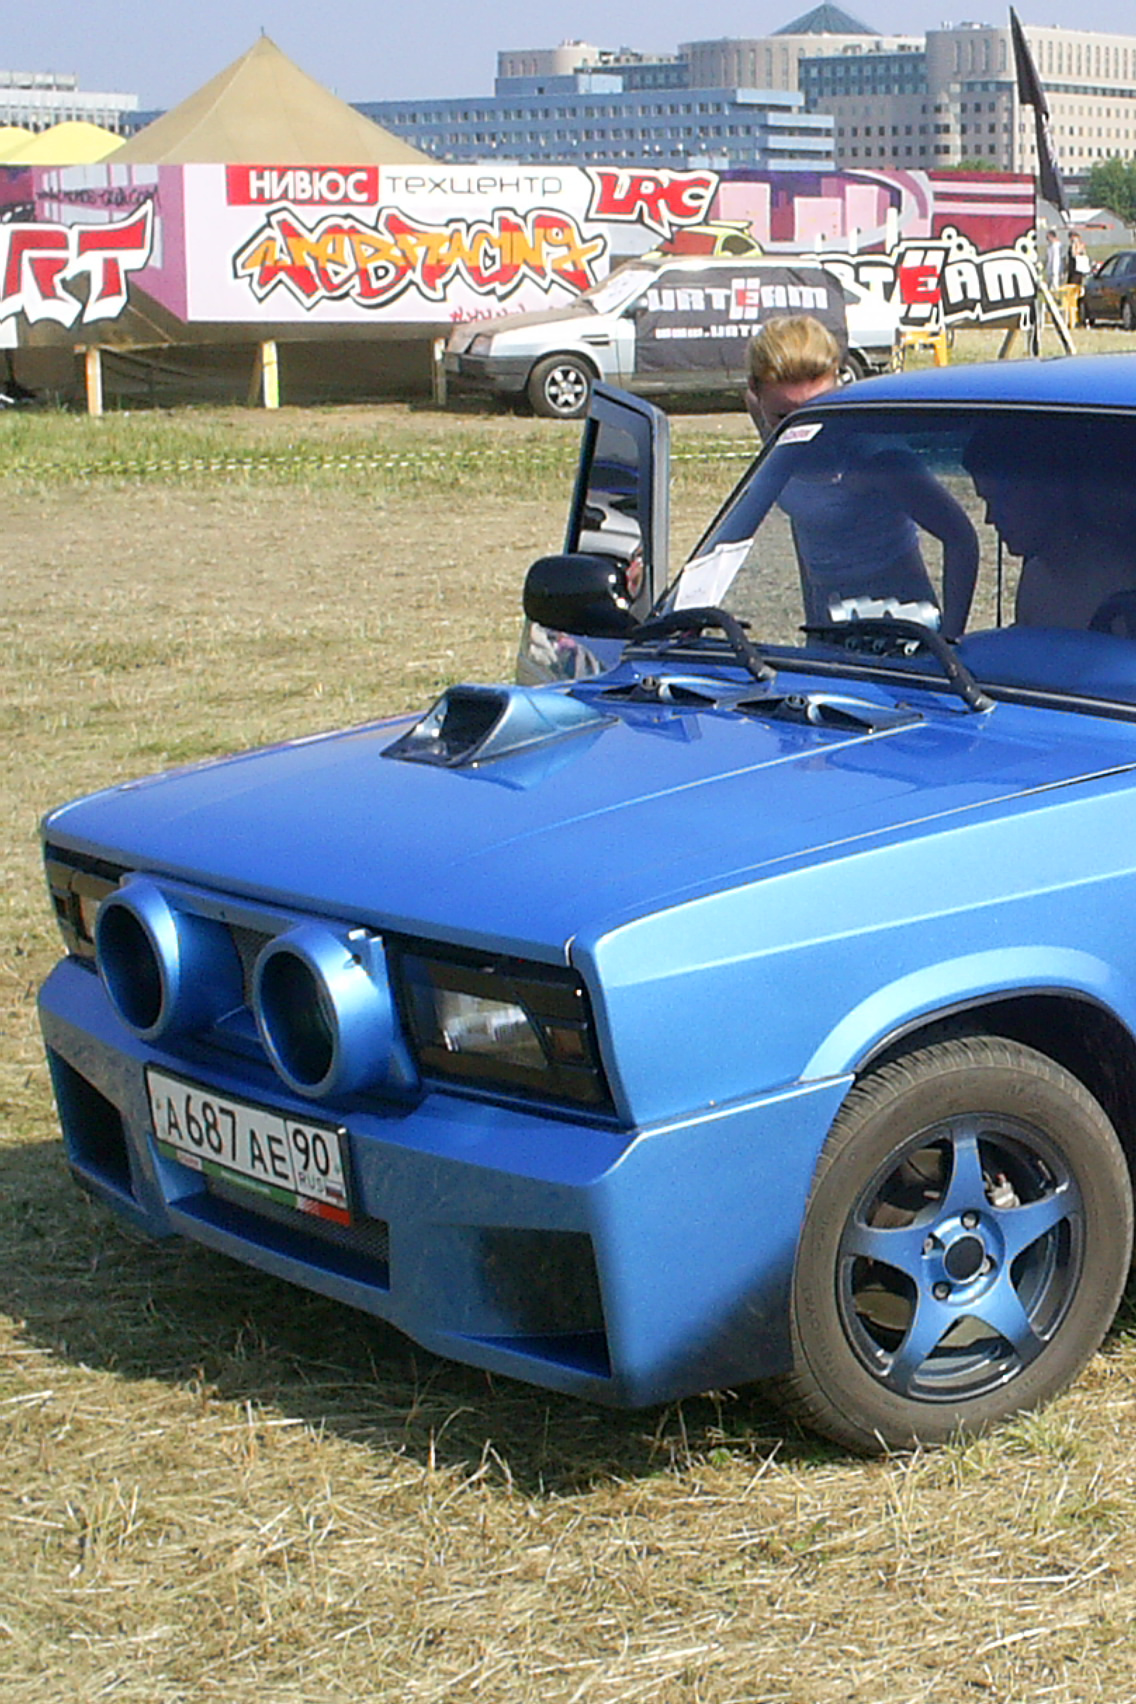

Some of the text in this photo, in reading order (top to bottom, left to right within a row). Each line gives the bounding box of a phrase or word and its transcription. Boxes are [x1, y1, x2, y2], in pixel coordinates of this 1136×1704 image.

[249, 169, 563, 202] НИВЮС техцентр
[292, 1128, 330, 1177] 90
